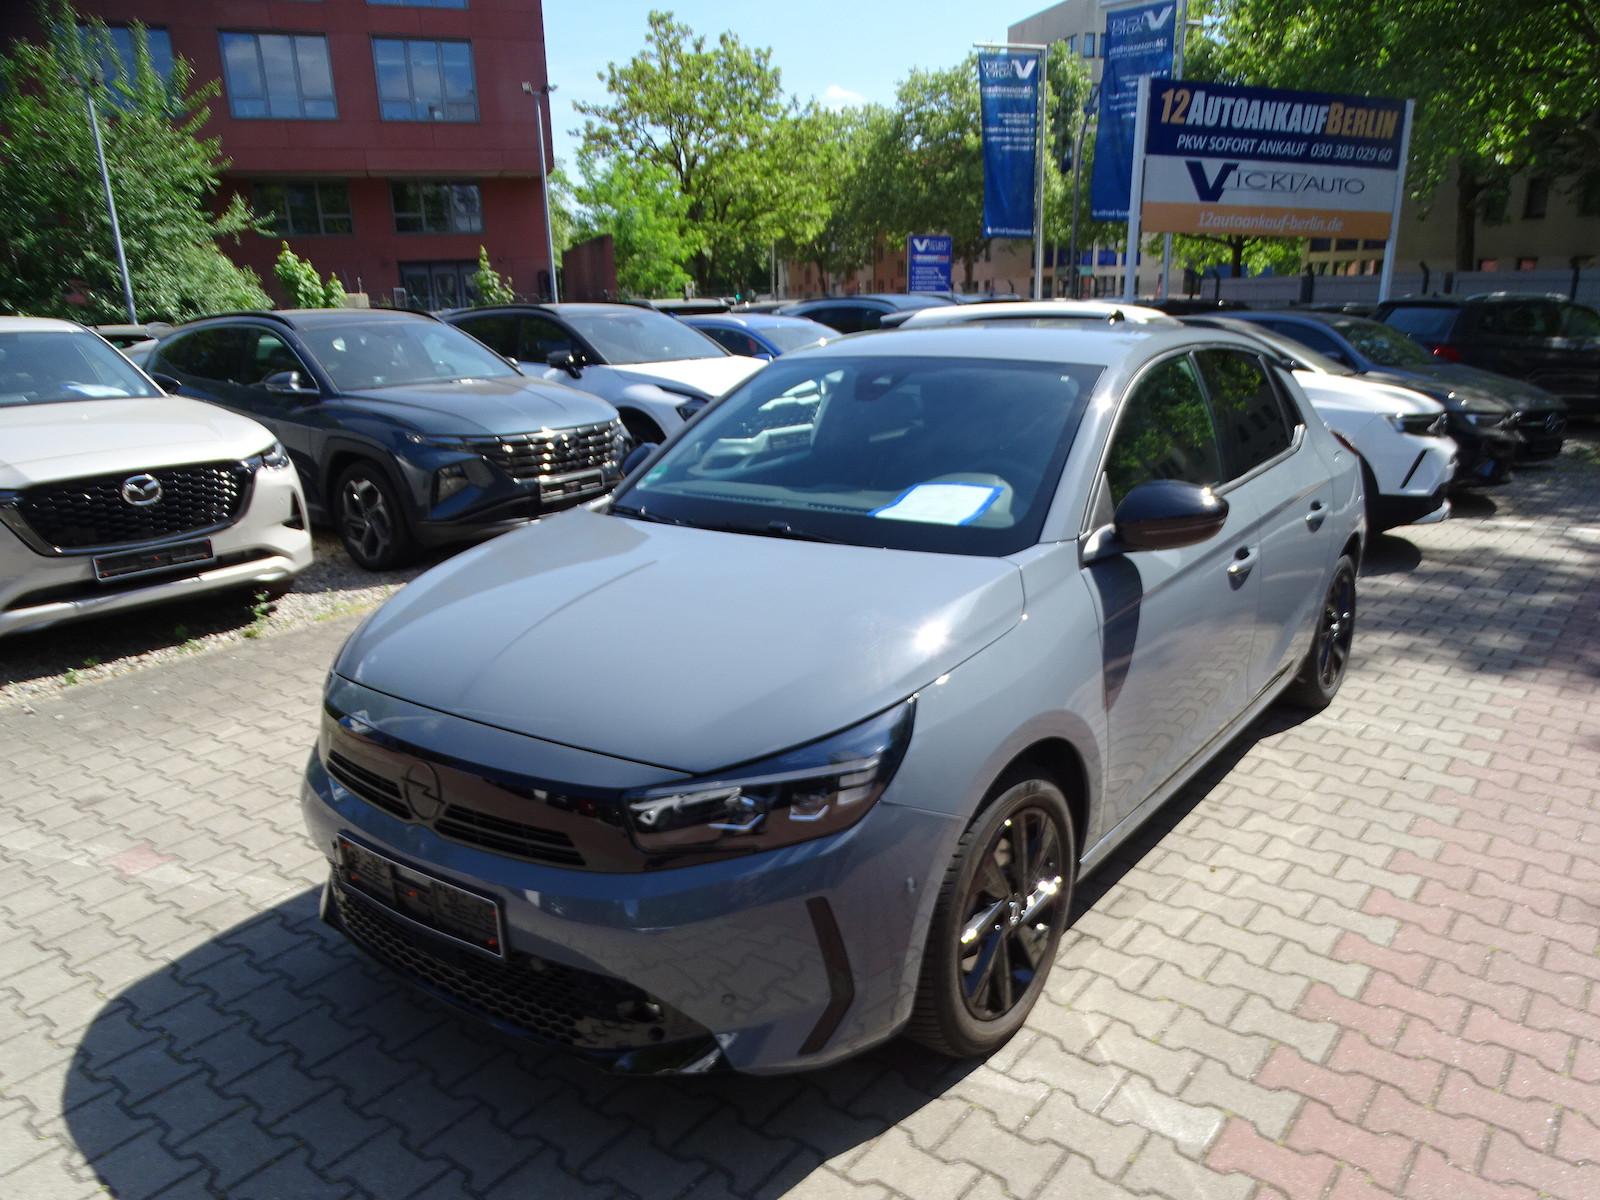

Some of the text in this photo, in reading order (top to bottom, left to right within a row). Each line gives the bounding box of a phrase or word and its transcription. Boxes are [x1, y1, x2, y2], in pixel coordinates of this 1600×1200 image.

[1176, 133, 1393, 162] PKW SOFORT ANKAUF 030 383 029 60
[1200, 210, 1344, 232] 12autoankauf-berlin.de
